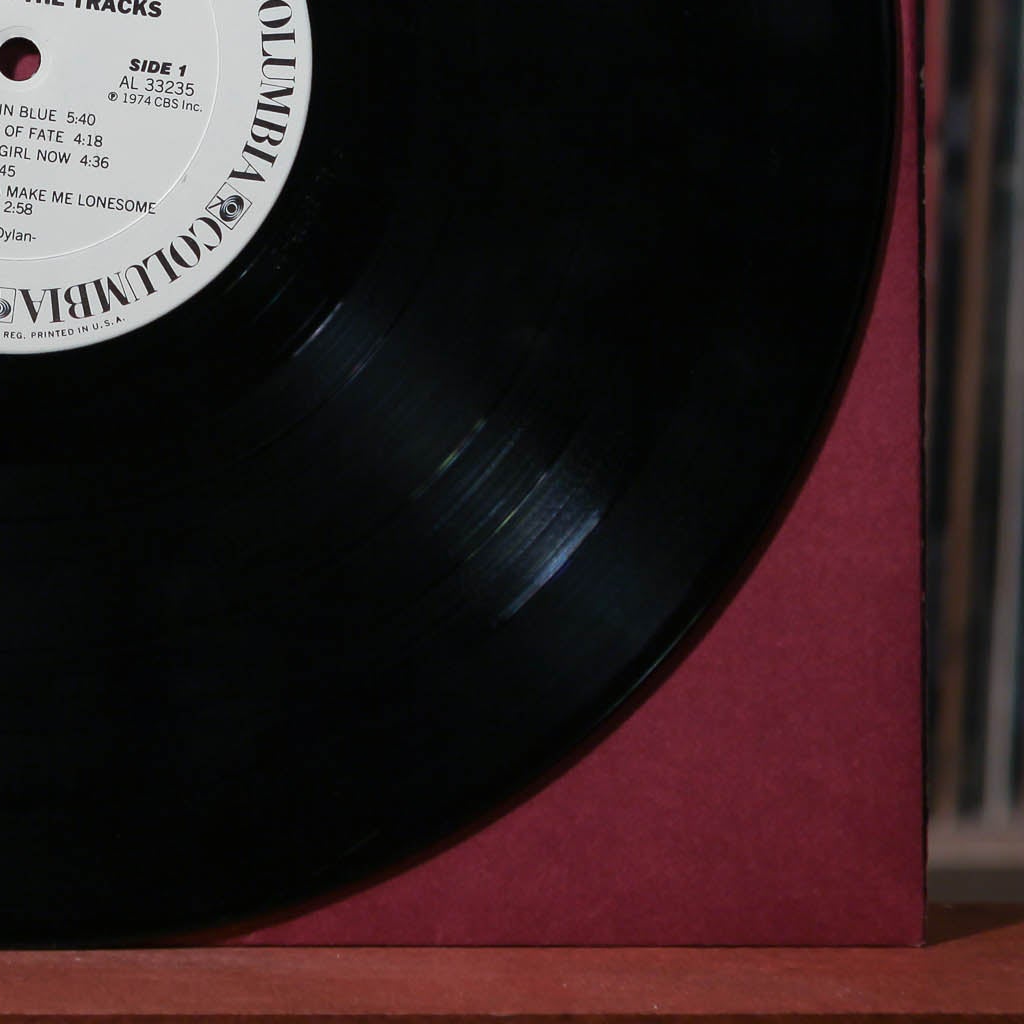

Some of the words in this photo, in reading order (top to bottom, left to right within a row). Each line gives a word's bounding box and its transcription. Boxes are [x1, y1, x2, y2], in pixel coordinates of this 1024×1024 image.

[129, 58, 172, 75] SIDE
[178, 64, 187, 77] 1
[119, 75, 139, 90] AL
[144, 78, 195, 97] 33235
[123, 92, 151, 106] 1974
[154, 96, 179, 110] CBS
[182, 99, 203, 112] Inc.
[0, 103, 14, 116] IN
[19, 106, 57, 122] BLUE
[66, 112, 96, 126] 5:40
[4, 125, 24, 138] OF
[29, 126, 64, 143] FATE
[73, 133, 103, 147] 4:18
[37, 149, 71, 164] NOW
[79, 155, 109, 169] 4:36
[3, 201, 33, 215] 2:58
[6, 185, 47, 202] MAKE
[52, 191, 74, 205] ME
[78, 194, 156, 214] LONESOME
[19, 216, 222, 323] COLUMBIA
[3, 331, 26, 340] REG.
[31, 329, 74, 339] PRINTED
[77, 326, 89, 334] IN
